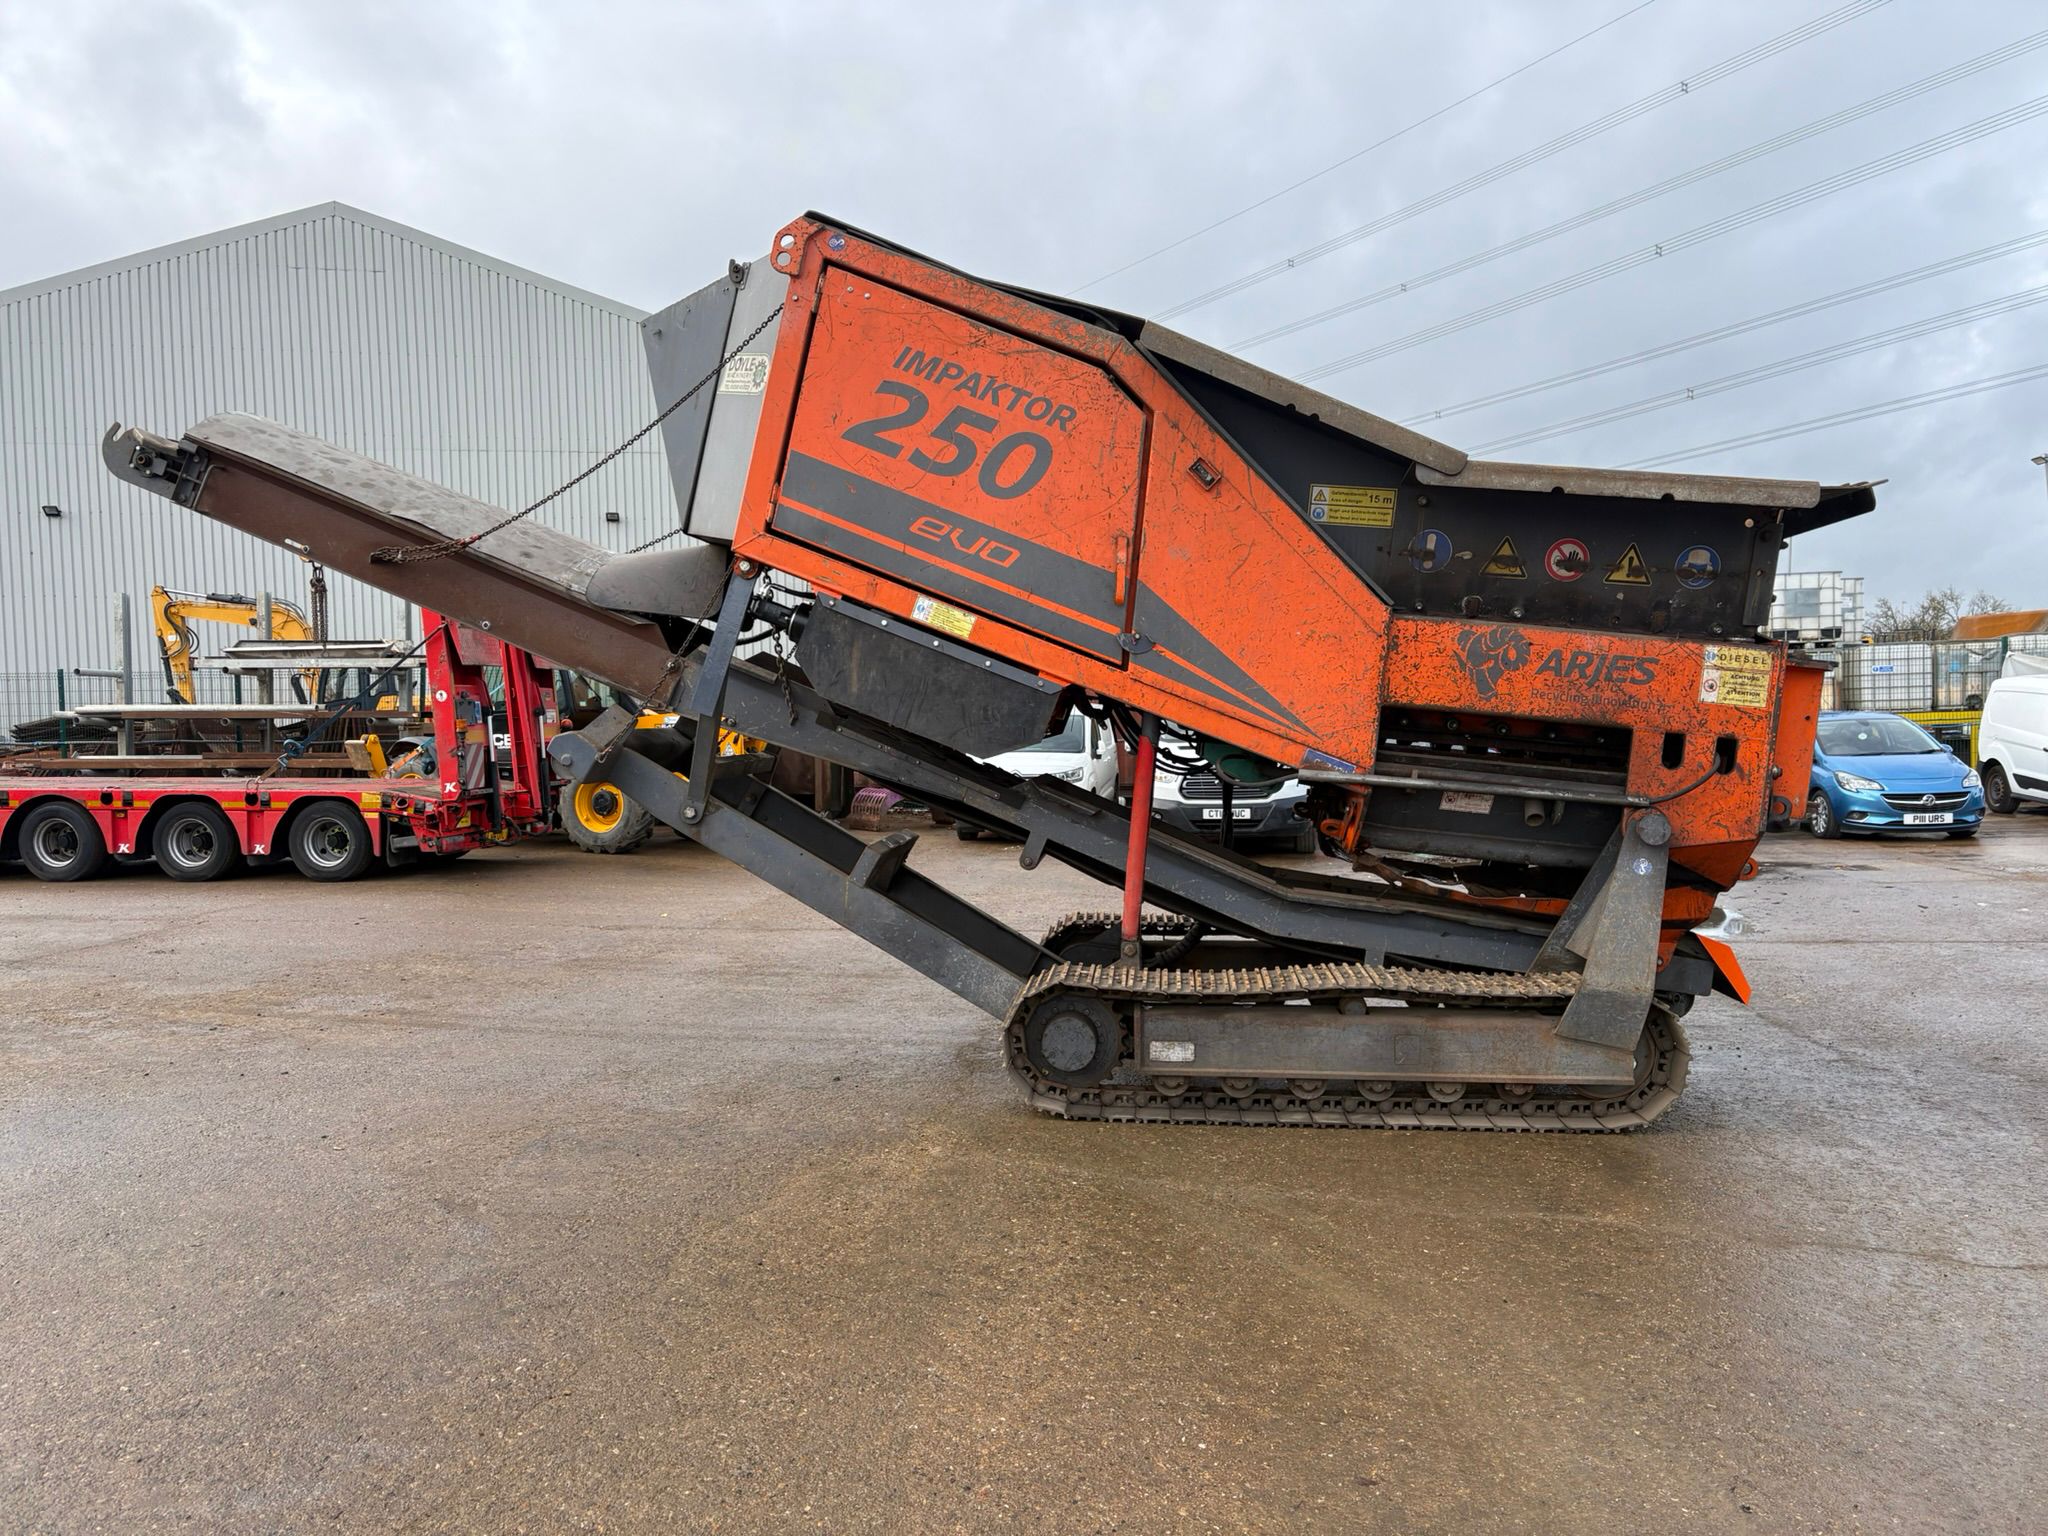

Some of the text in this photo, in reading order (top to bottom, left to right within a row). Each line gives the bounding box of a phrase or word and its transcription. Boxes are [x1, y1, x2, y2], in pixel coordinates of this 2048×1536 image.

[728, 357, 756, 371] DOYLE
[892, 346, 1077, 432] IMPAKTOR
[840, 379, 1053, 500] 250
[1368, 494, 1380, 504] 15
[908, 516, 1021, 568] evo
[1720, 653, 1767, 665] DIESEL
[1535, 648, 1660, 688] ARJES
[1530, 687, 1588, 707] Recycling
[1726, 689, 1760, 697] ATTENTION
[1928, 814, 1945, 823] URS
